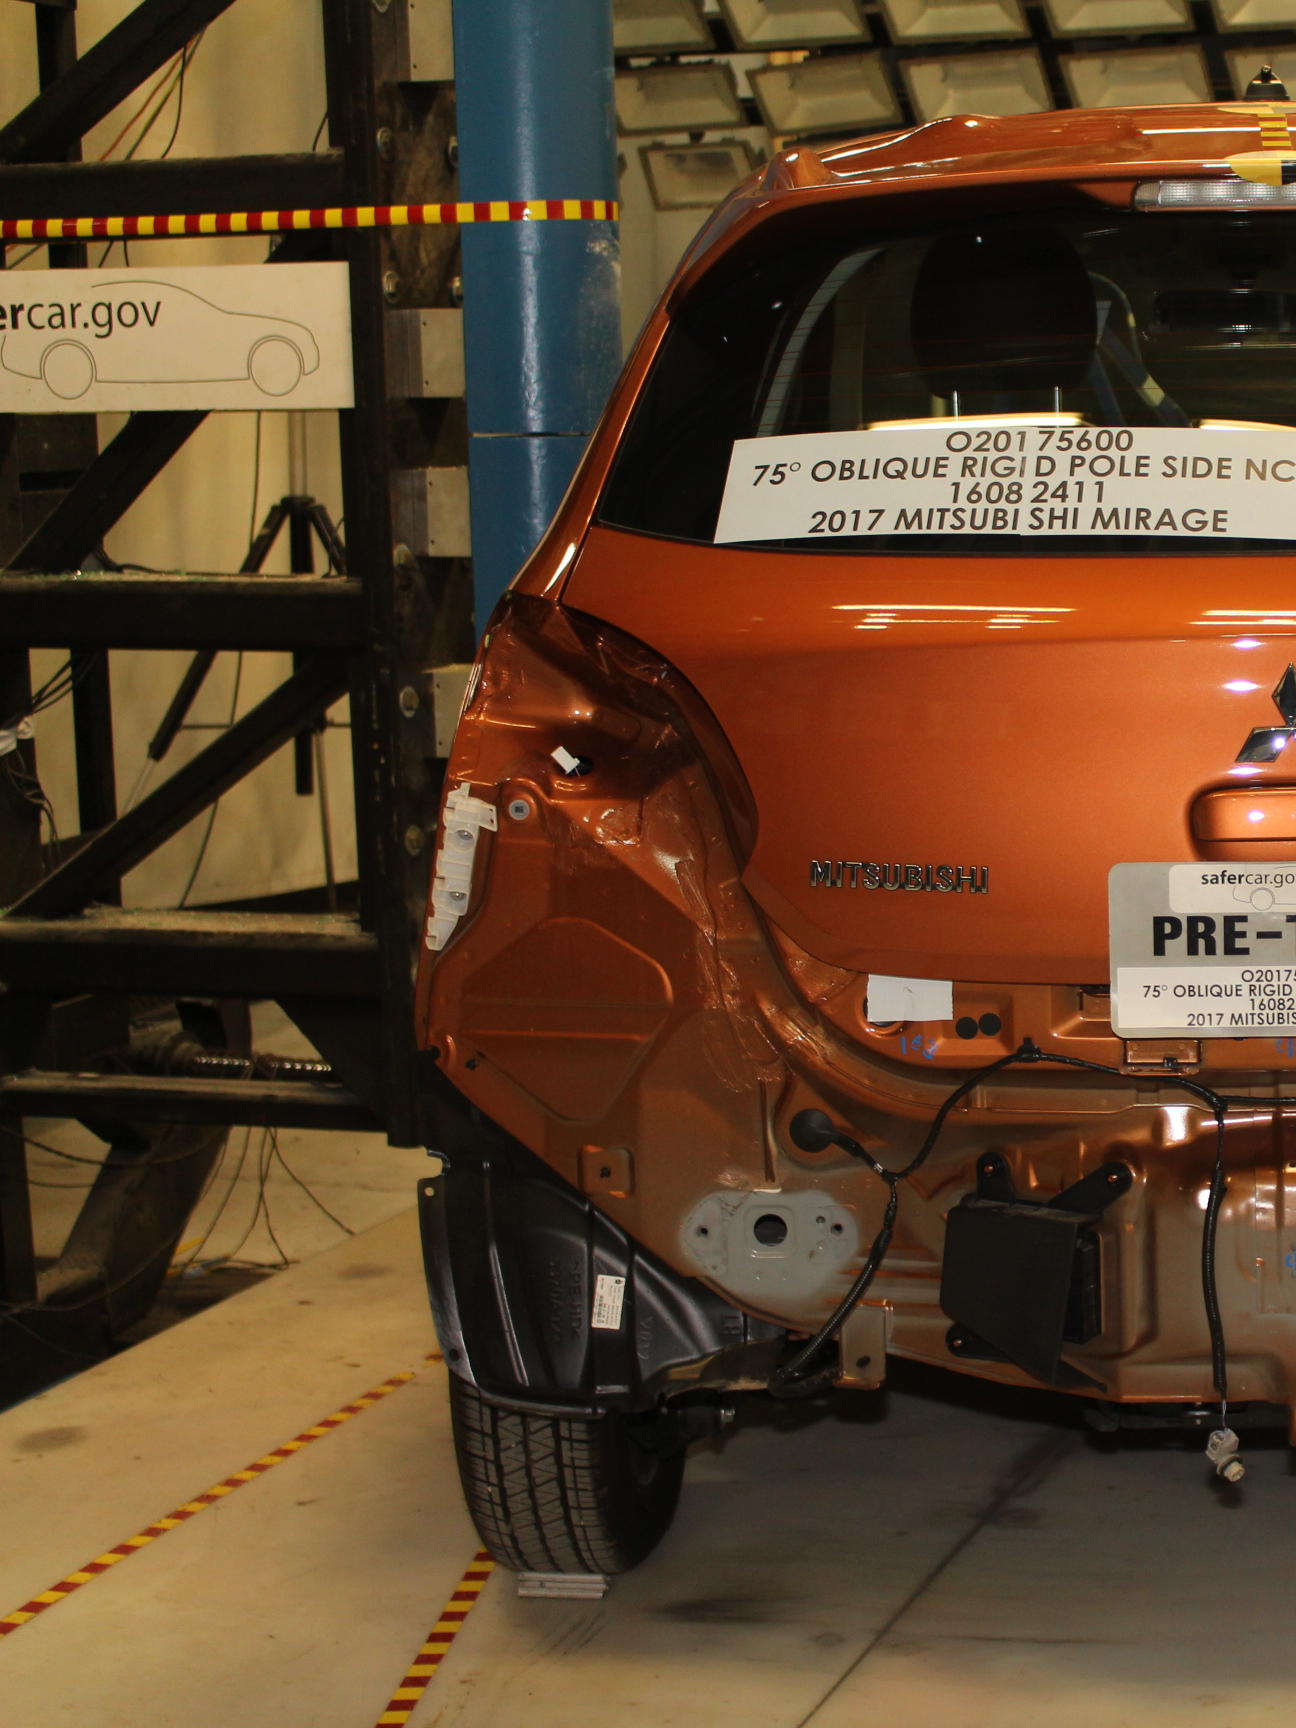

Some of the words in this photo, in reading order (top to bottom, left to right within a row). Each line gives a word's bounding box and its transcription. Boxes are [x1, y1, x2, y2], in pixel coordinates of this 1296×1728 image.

[752, 461, 802, 487] 75°
[810, 456, 951, 482] OBLIQUE
[1068, 454, 1151, 478] POLE
[1161, 456, 1233, 480] SIDE
[808, 508, 886, 533] 2017
[1090, 506, 1229, 533] MIRAGE
[810, 859, 989, 894] MITSUBISHI
[1142, 984, 1169, 998] 75°
[1173, 983, 1243, 999] OBLIQUE
[1248, 983, 1294, 998] RIGID
[1186, 1012, 1225, 1027] 2017
